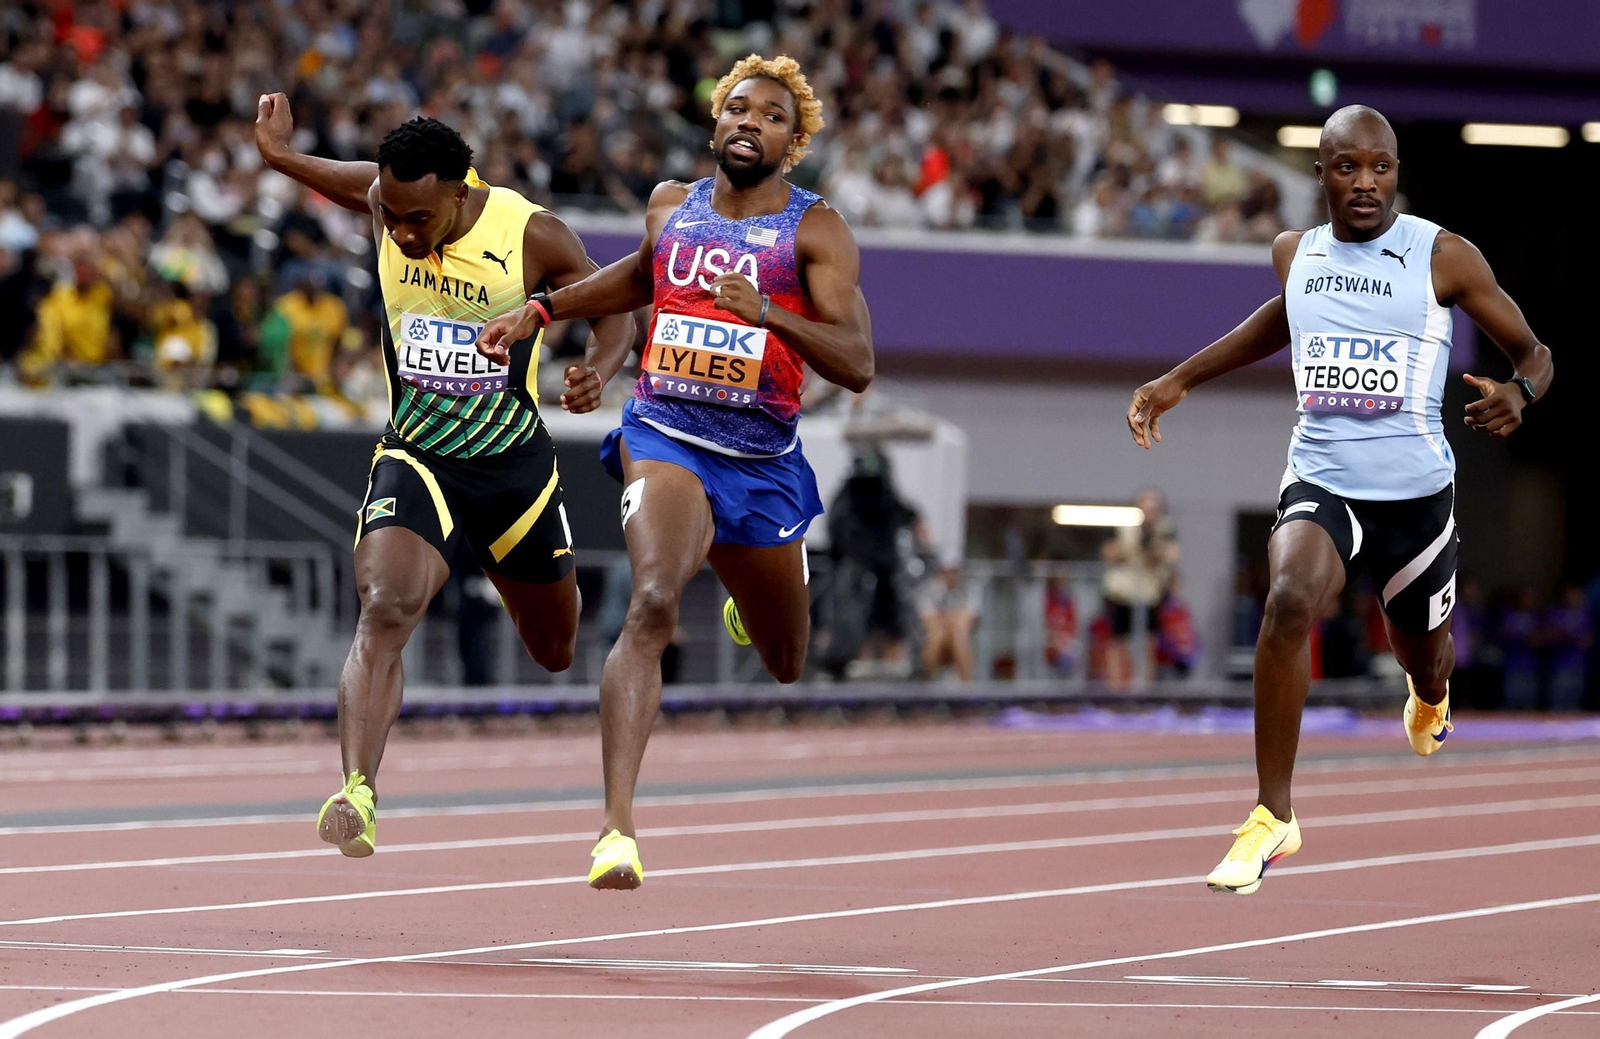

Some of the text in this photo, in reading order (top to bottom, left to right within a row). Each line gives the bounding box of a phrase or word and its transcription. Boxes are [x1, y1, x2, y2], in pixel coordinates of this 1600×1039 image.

[399, 264, 490, 306] JAMAICA
[1305, 276, 1393, 298] BOTSWANA
[429, 320, 484, 346] TD
[681, 320, 757, 355] TDK
[1327, 337, 1399, 362] TDK
[657, 347, 747, 383] LYLES
[1304, 366, 1399, 393] TEBOGO
[1440, 586, 1452, 618] 5
